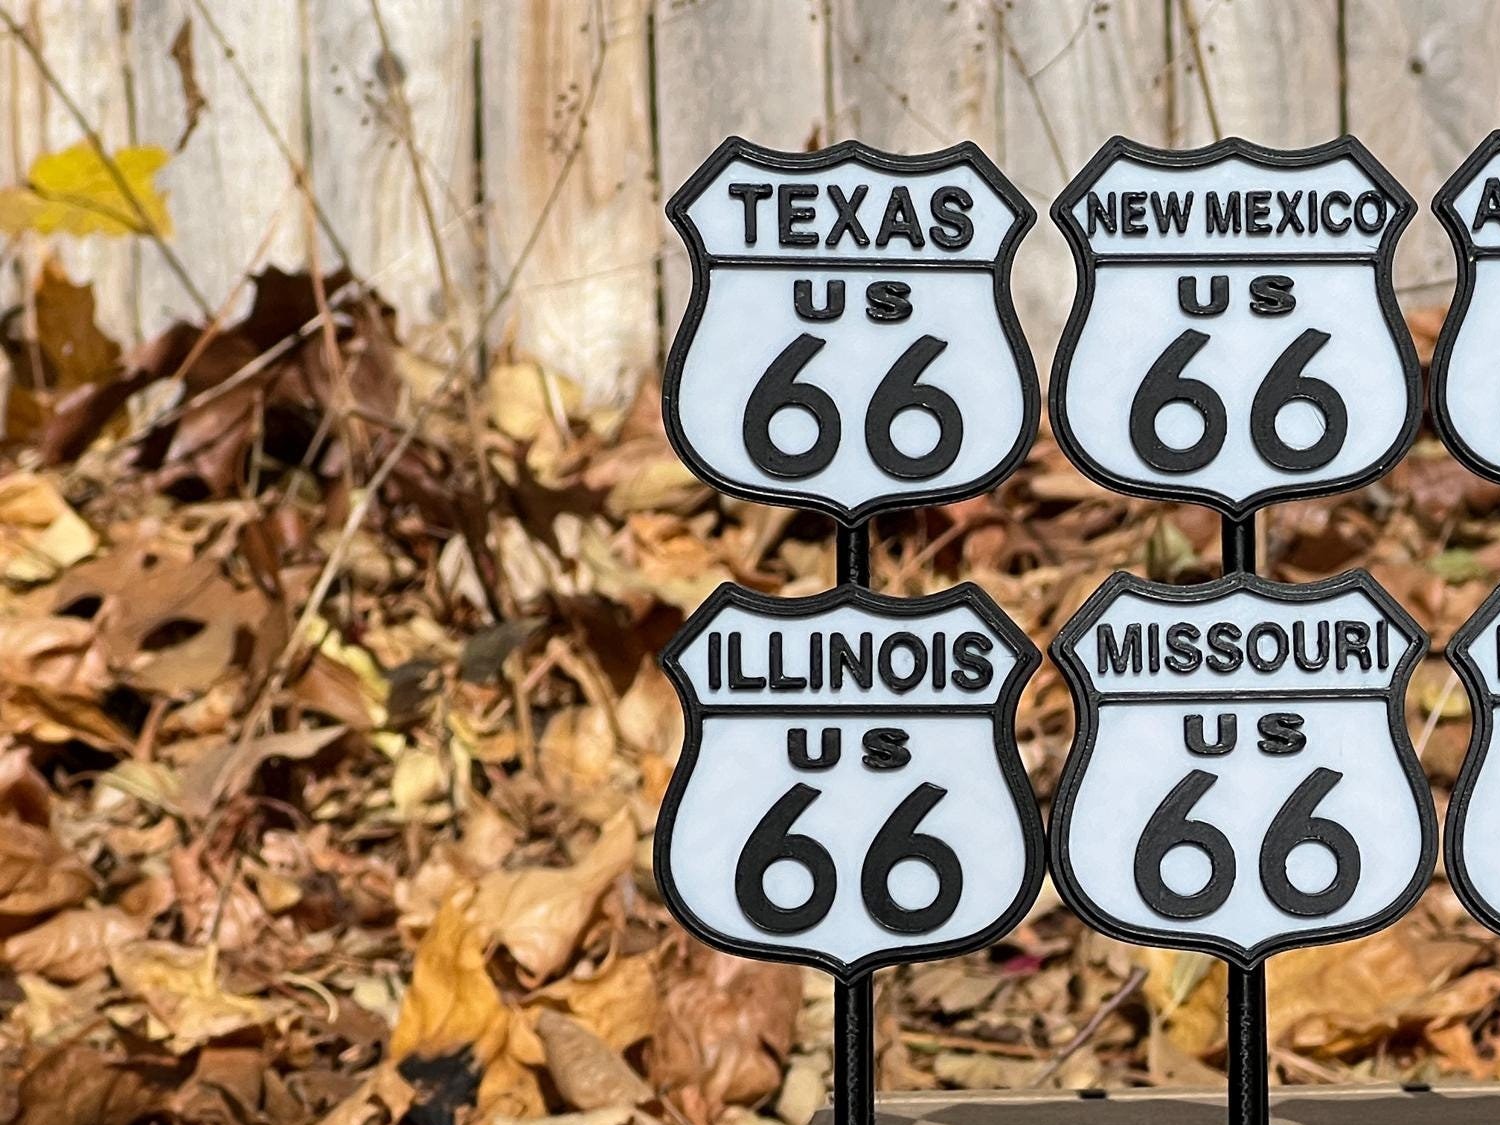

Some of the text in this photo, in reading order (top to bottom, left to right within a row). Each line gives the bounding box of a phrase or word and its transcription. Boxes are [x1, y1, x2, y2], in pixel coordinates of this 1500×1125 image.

[729, 184, 974, 249] TEXAS
[1088, 190, 1388, 235] NEW MEXICO
[793, 279, 914, 322] US
[1179, 275, 1296, 315] US
[742, 332, 964, 479] 66
[1130, 328, 1348, 474] 66
[707, 631, 994, 692] ILLINOIS
[1097, 620, 1389, 674] MISSOURI
[787, 728, 911, 769] US
[1183, 712, 1308, 754] US
[734, 782, 963, 934] 66
[1134, 768, 1361, 919] 66
